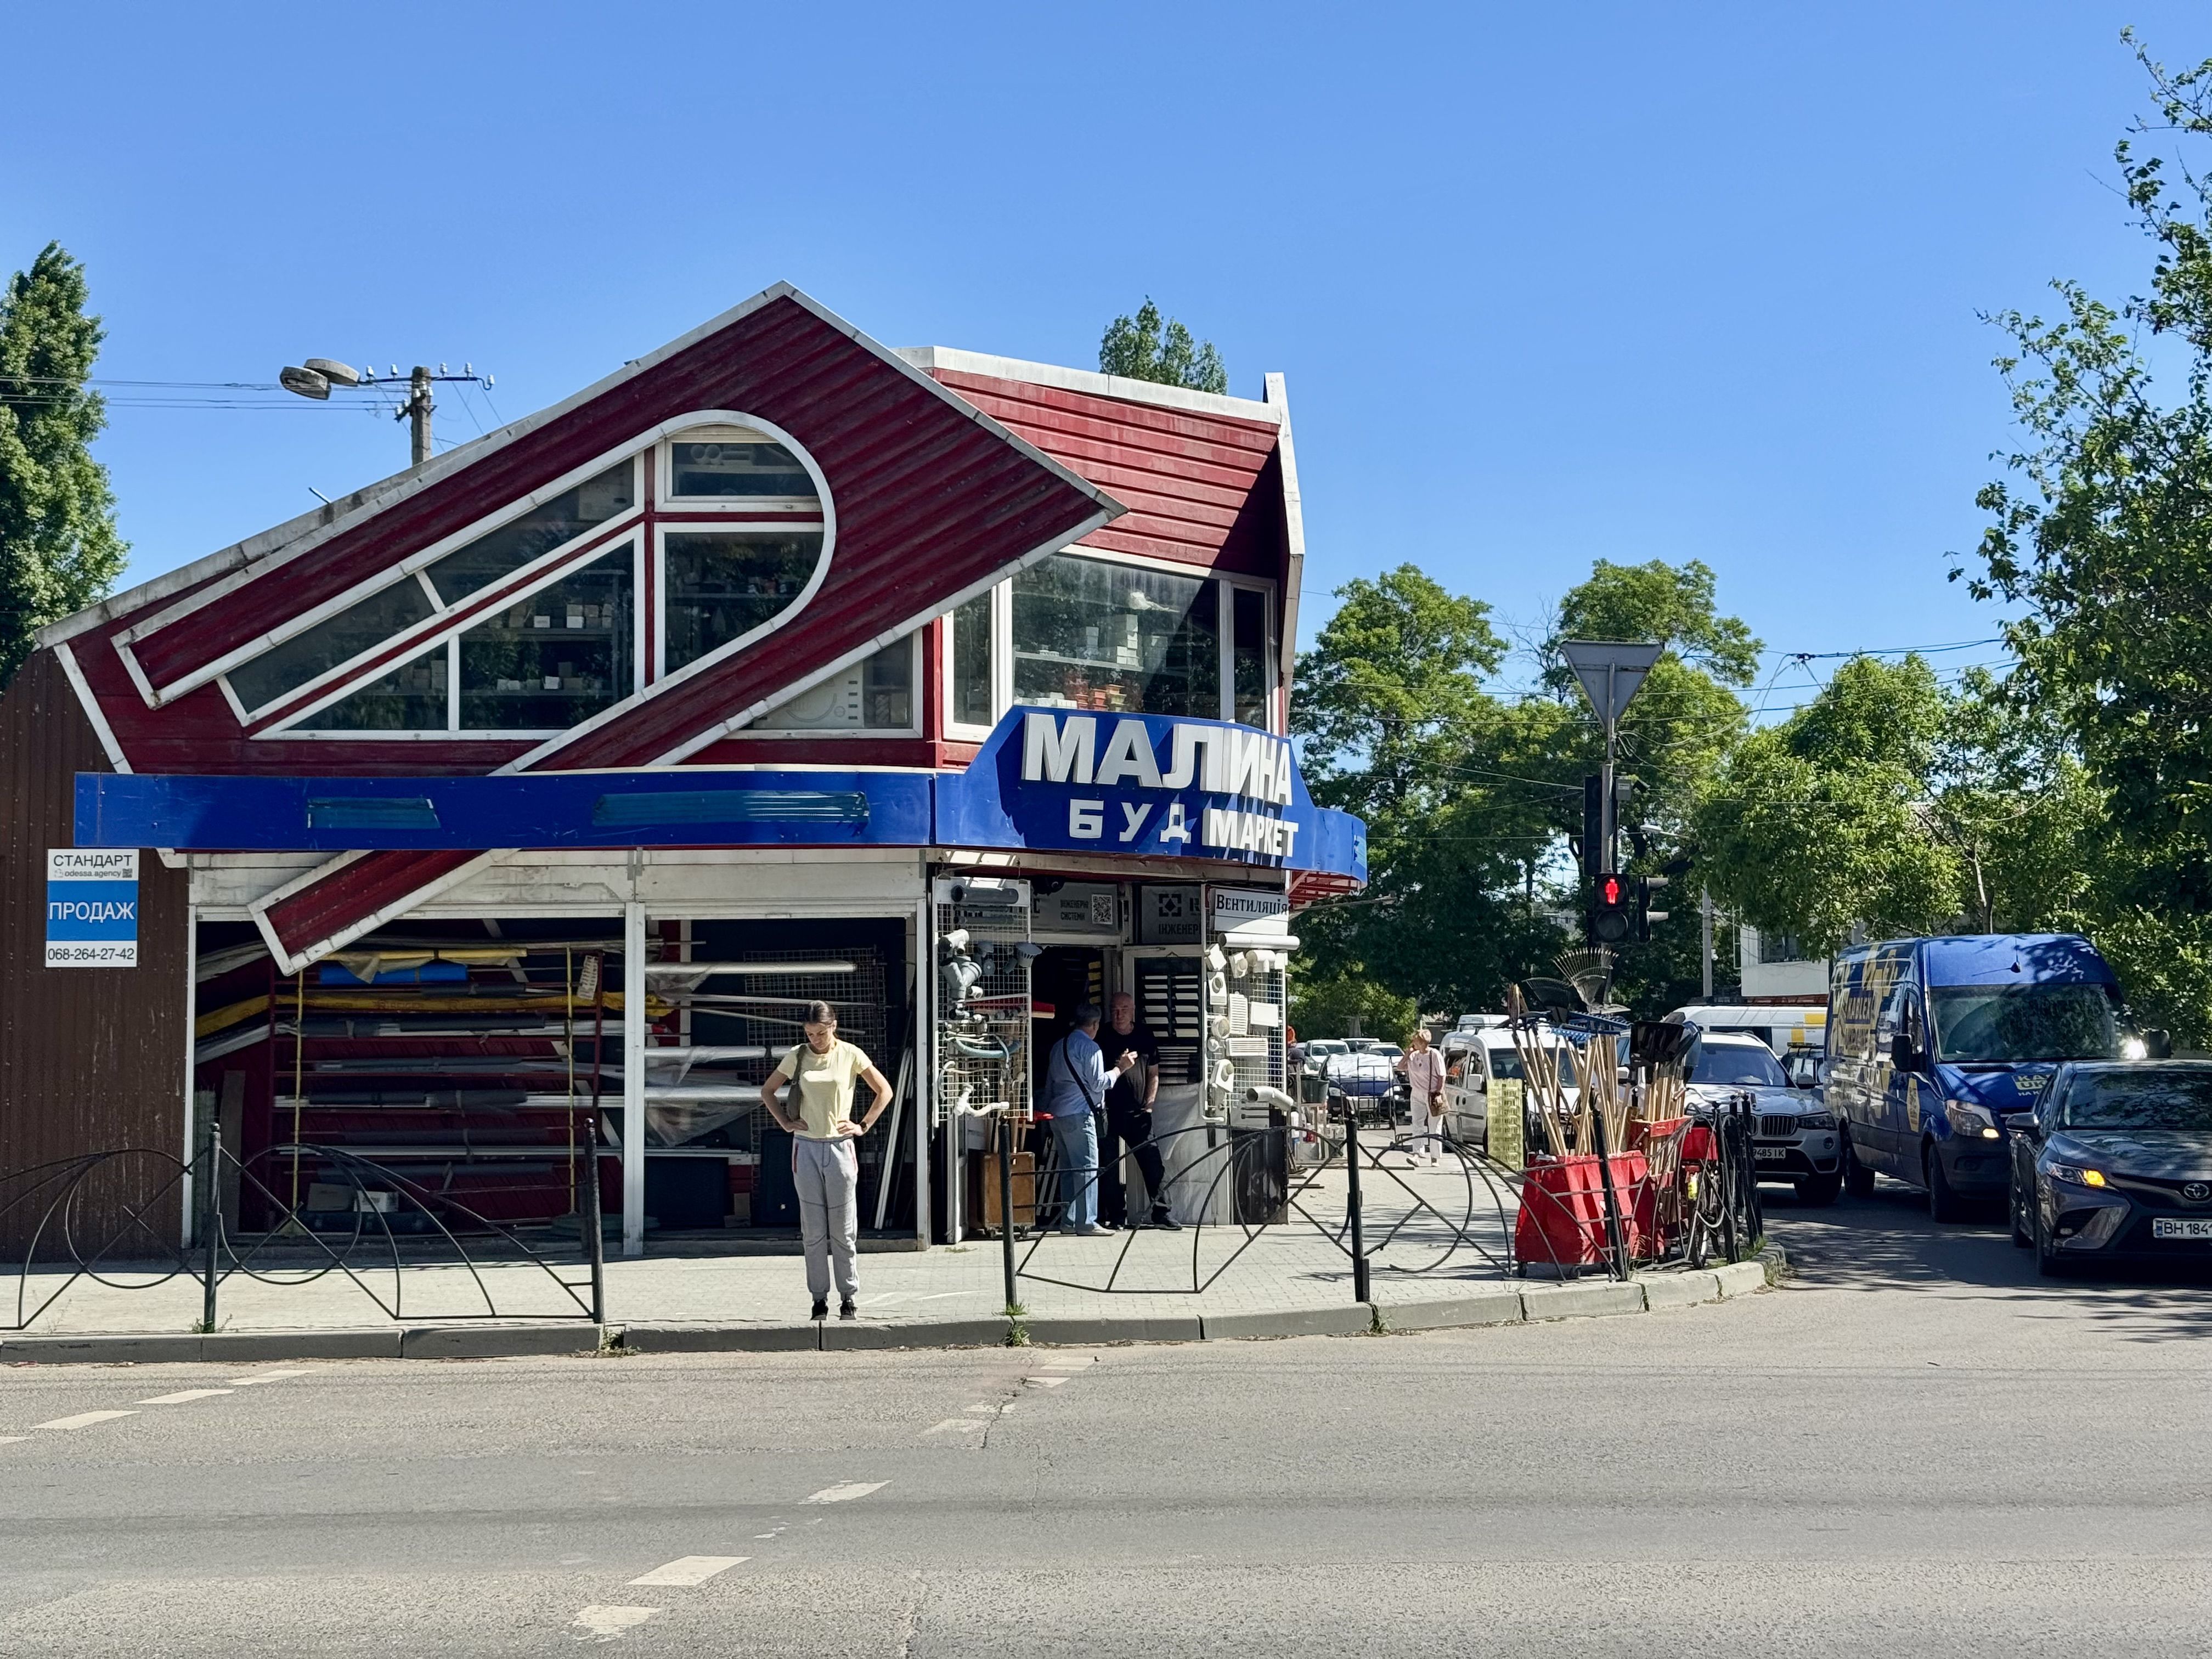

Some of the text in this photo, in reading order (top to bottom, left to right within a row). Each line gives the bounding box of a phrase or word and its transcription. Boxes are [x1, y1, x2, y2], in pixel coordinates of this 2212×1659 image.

[1021, 713, 1293, 806] МАЛИНА
[1069, 798, 1299, 857] БУД МАРКЕТ
[53, 855, 133, 868] СТАНДАРТ
[49, 902, 135, 923] ПРОДАЖ
[48, 948, 134, 960] 068-264-27-42
